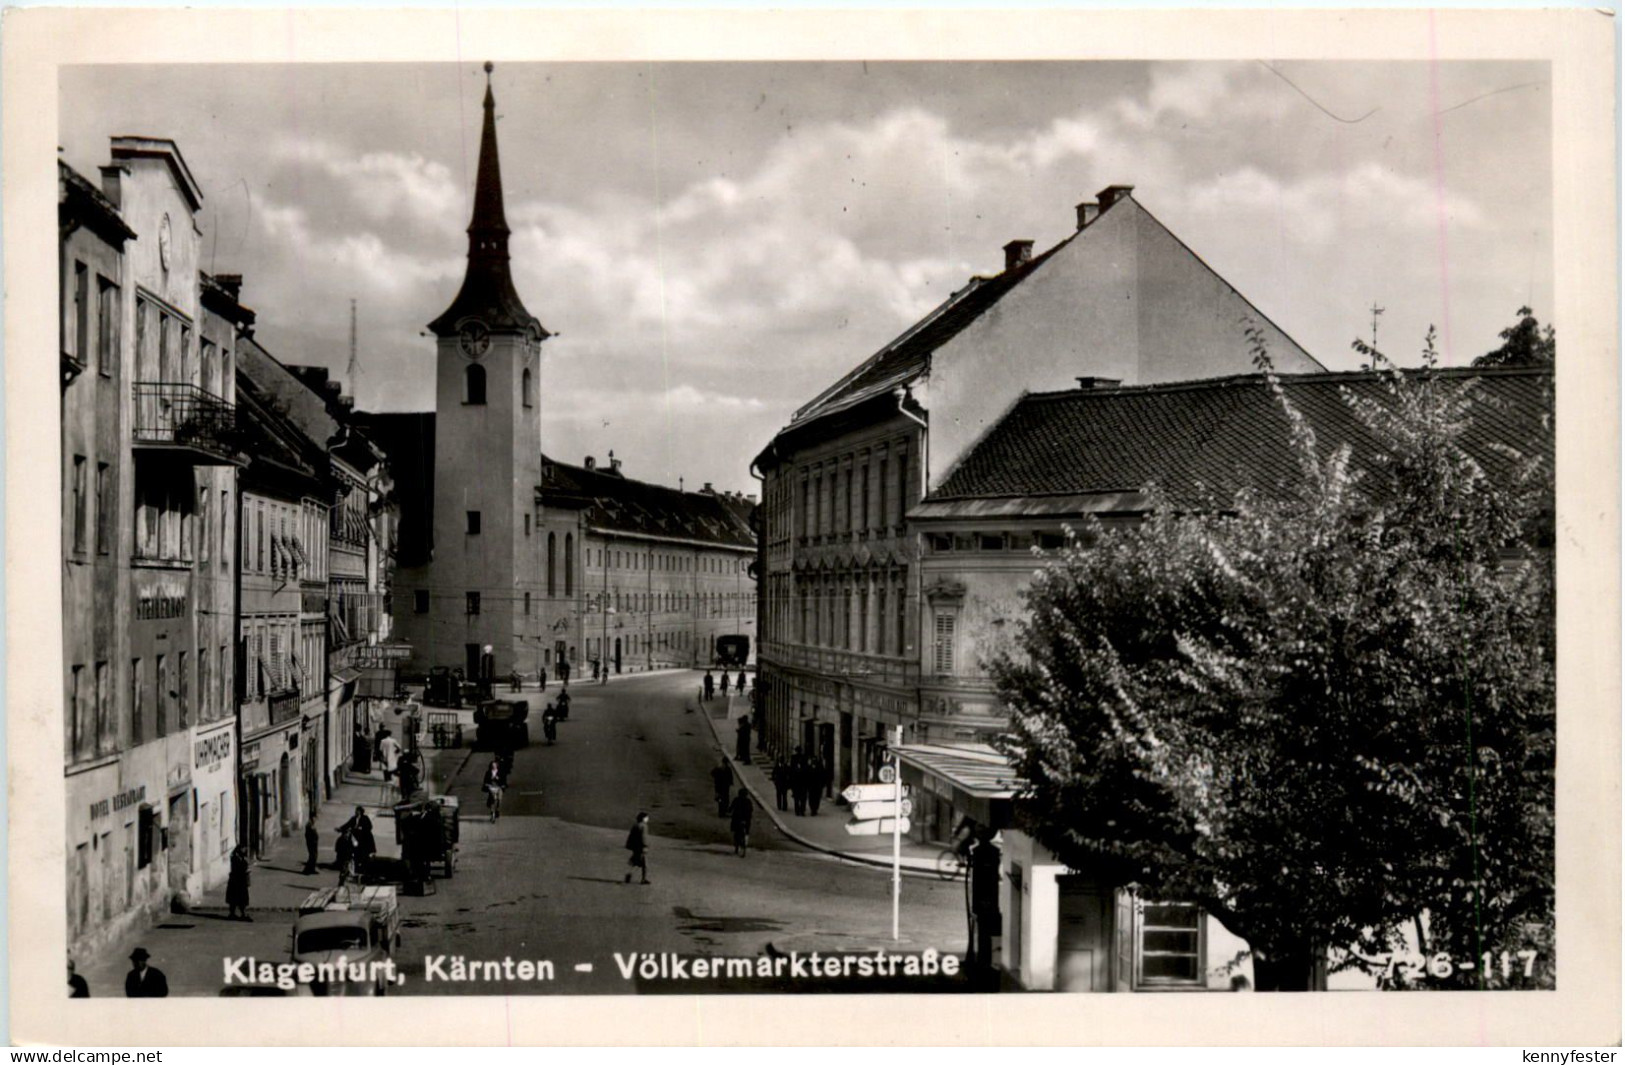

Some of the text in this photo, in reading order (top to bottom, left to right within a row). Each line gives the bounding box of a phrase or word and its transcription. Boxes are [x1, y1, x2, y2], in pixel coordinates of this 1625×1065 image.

[360, 647, 383, 658] AUTO
[194, 731, 230, 769] UHRMACHER
[90, 785, 146, 820] HOTEL RESTAURANT
